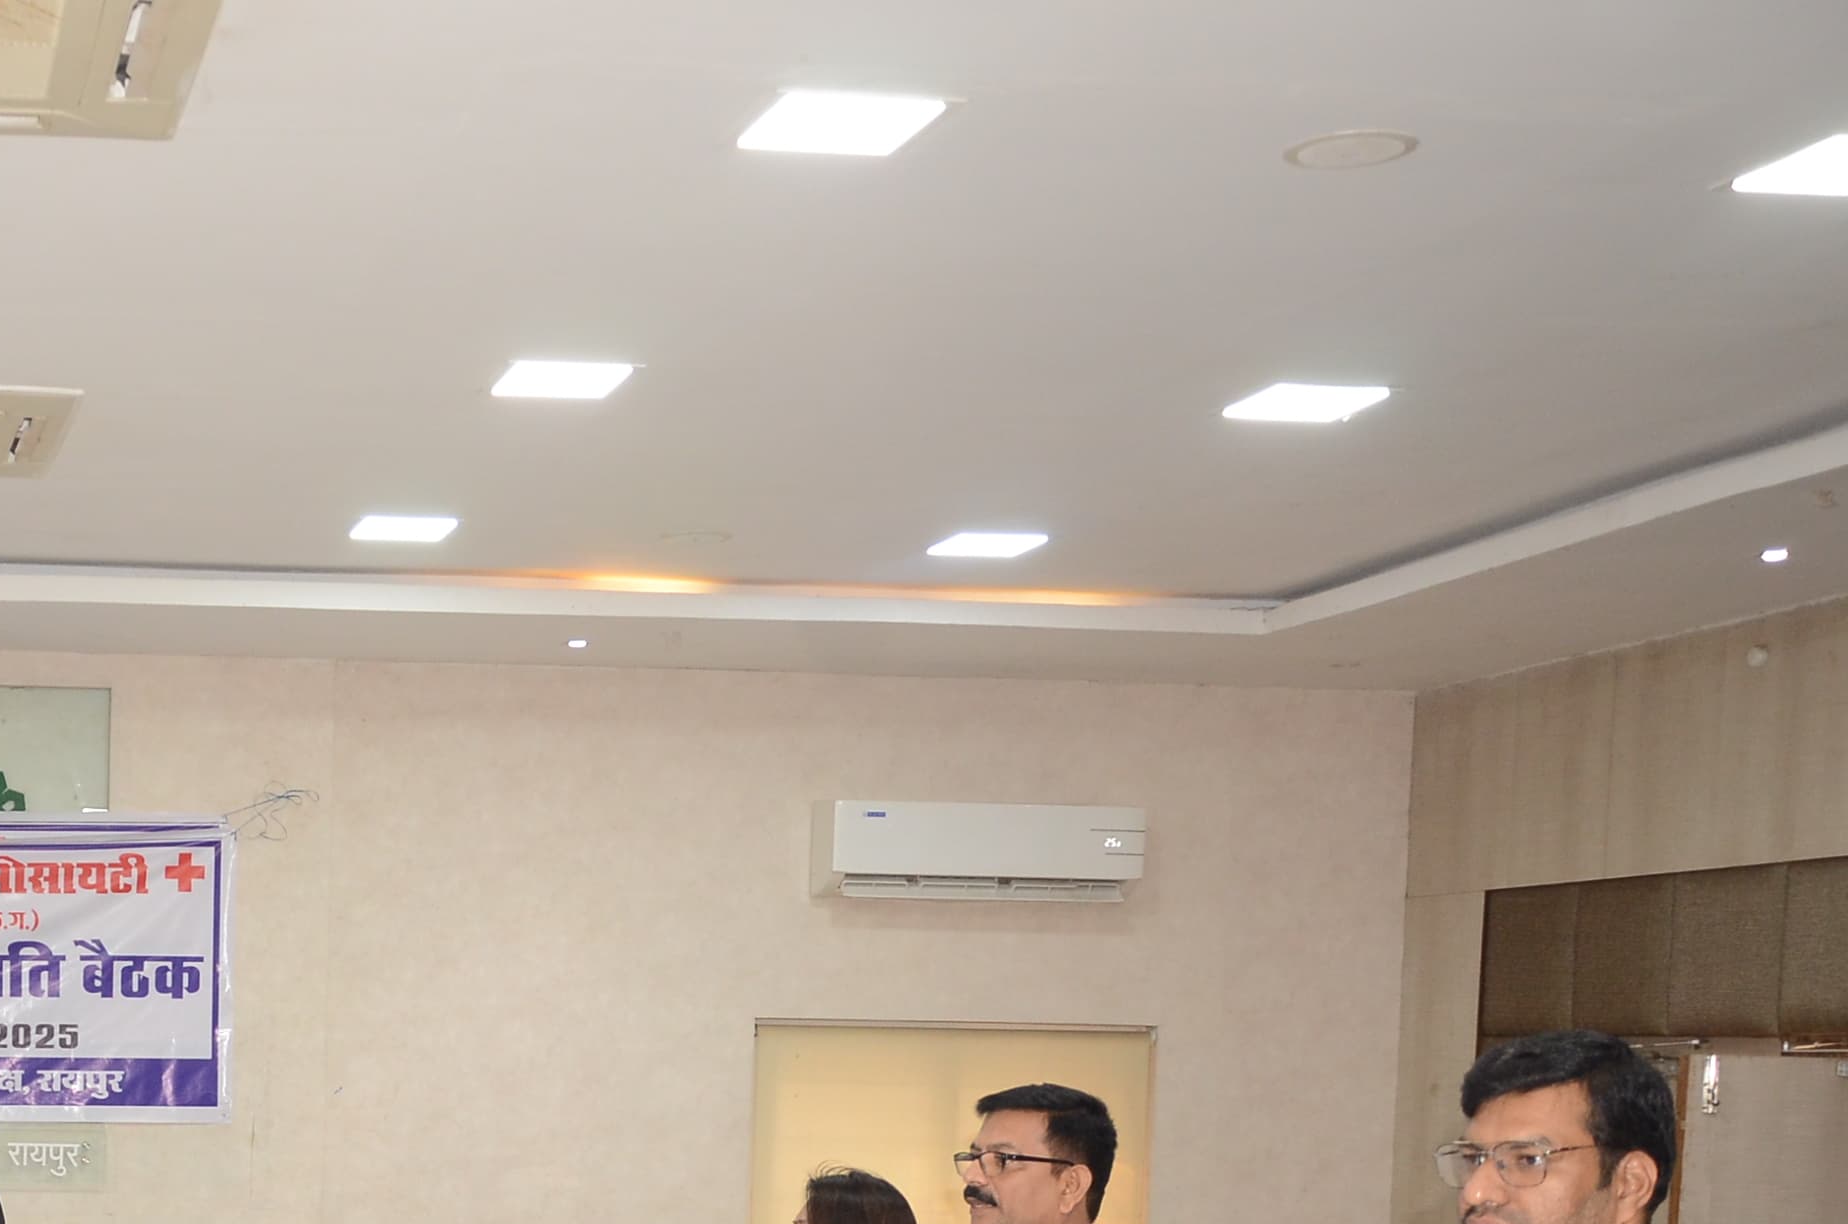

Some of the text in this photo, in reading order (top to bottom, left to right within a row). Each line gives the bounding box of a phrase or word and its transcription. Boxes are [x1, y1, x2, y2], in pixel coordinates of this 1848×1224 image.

[74, 939, 204, 999] बैठक
[38, 1069, 125, 1097] रायपुर
[7, 1141, 81, 1177] रायपुर
